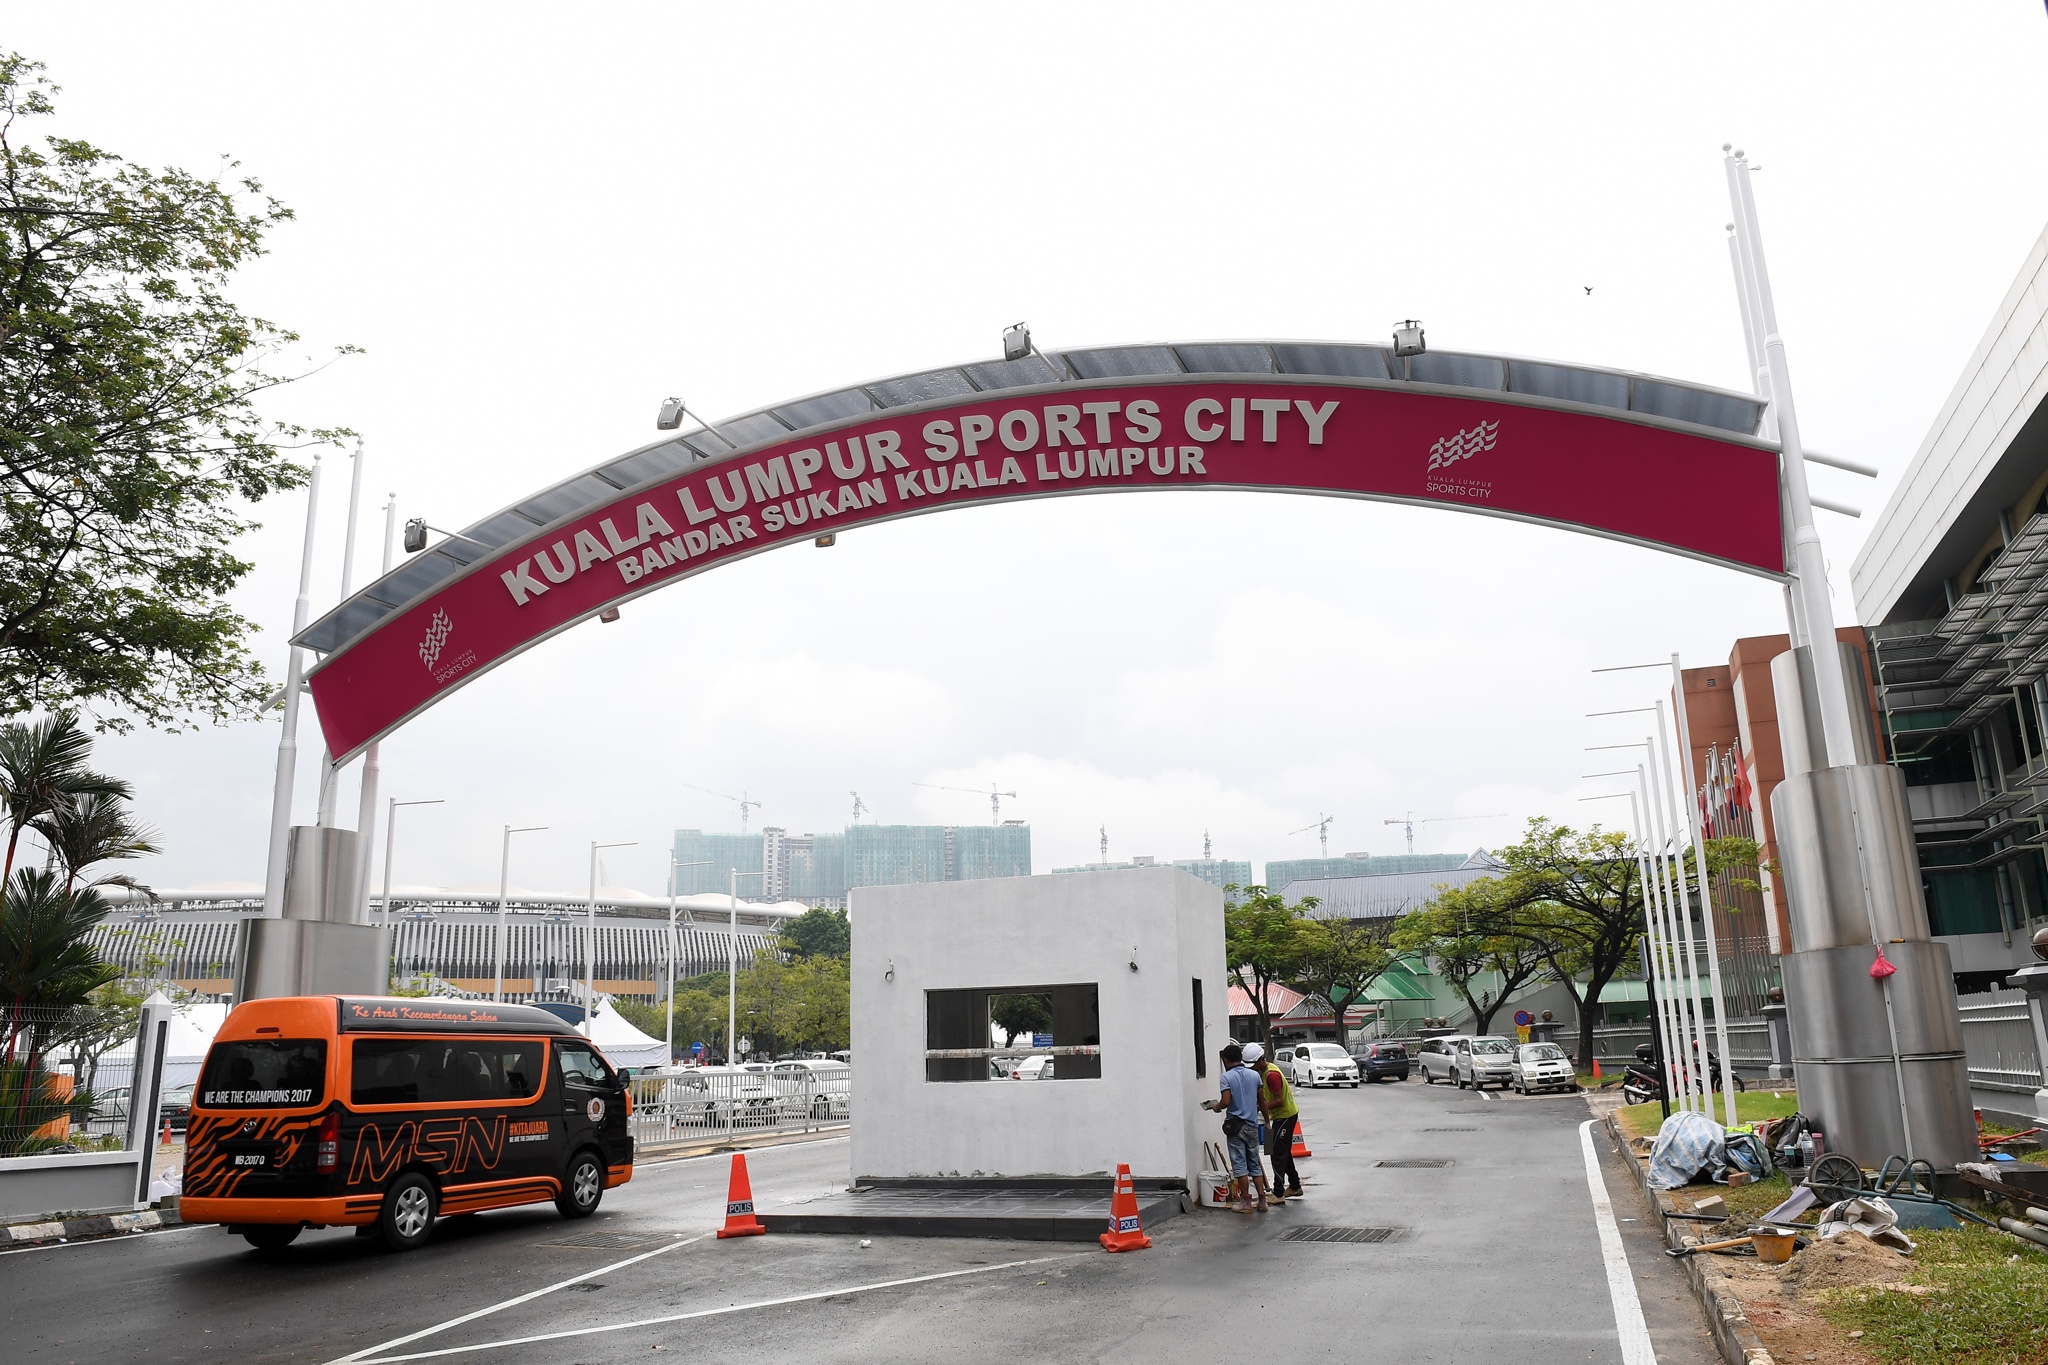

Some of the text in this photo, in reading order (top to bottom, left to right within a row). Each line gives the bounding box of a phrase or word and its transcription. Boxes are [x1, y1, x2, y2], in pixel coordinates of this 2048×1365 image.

[1426, 482, 1492, 499] SPORTS CITY
[1428, 475, 1492, 488] KUALA LUMPUR
[501, 398, 1341, 606] KUALA LUMPUR SPORTS CITY
[616, 446, 1207, 584] BANDAR SUKAN KUALA LUMPUR
[433, 649, 473, 676] KUALA LUMPUR
[436, 653, 477, 684] SPORTS CITY
[352, 1005, 498, 1024] Ke Arah Kecemerlangan Sukan
[204, 1088, 313, 1104] WE ARE THE CHAMPIONS 2017
[509, 1121, 549, 1136] #KITAJUARA
[347, 1115, 507, 1185] MSN
[729, 1202, 752, 1214] POLIS
[1120, 1219, 1138, 1230] POLIS
